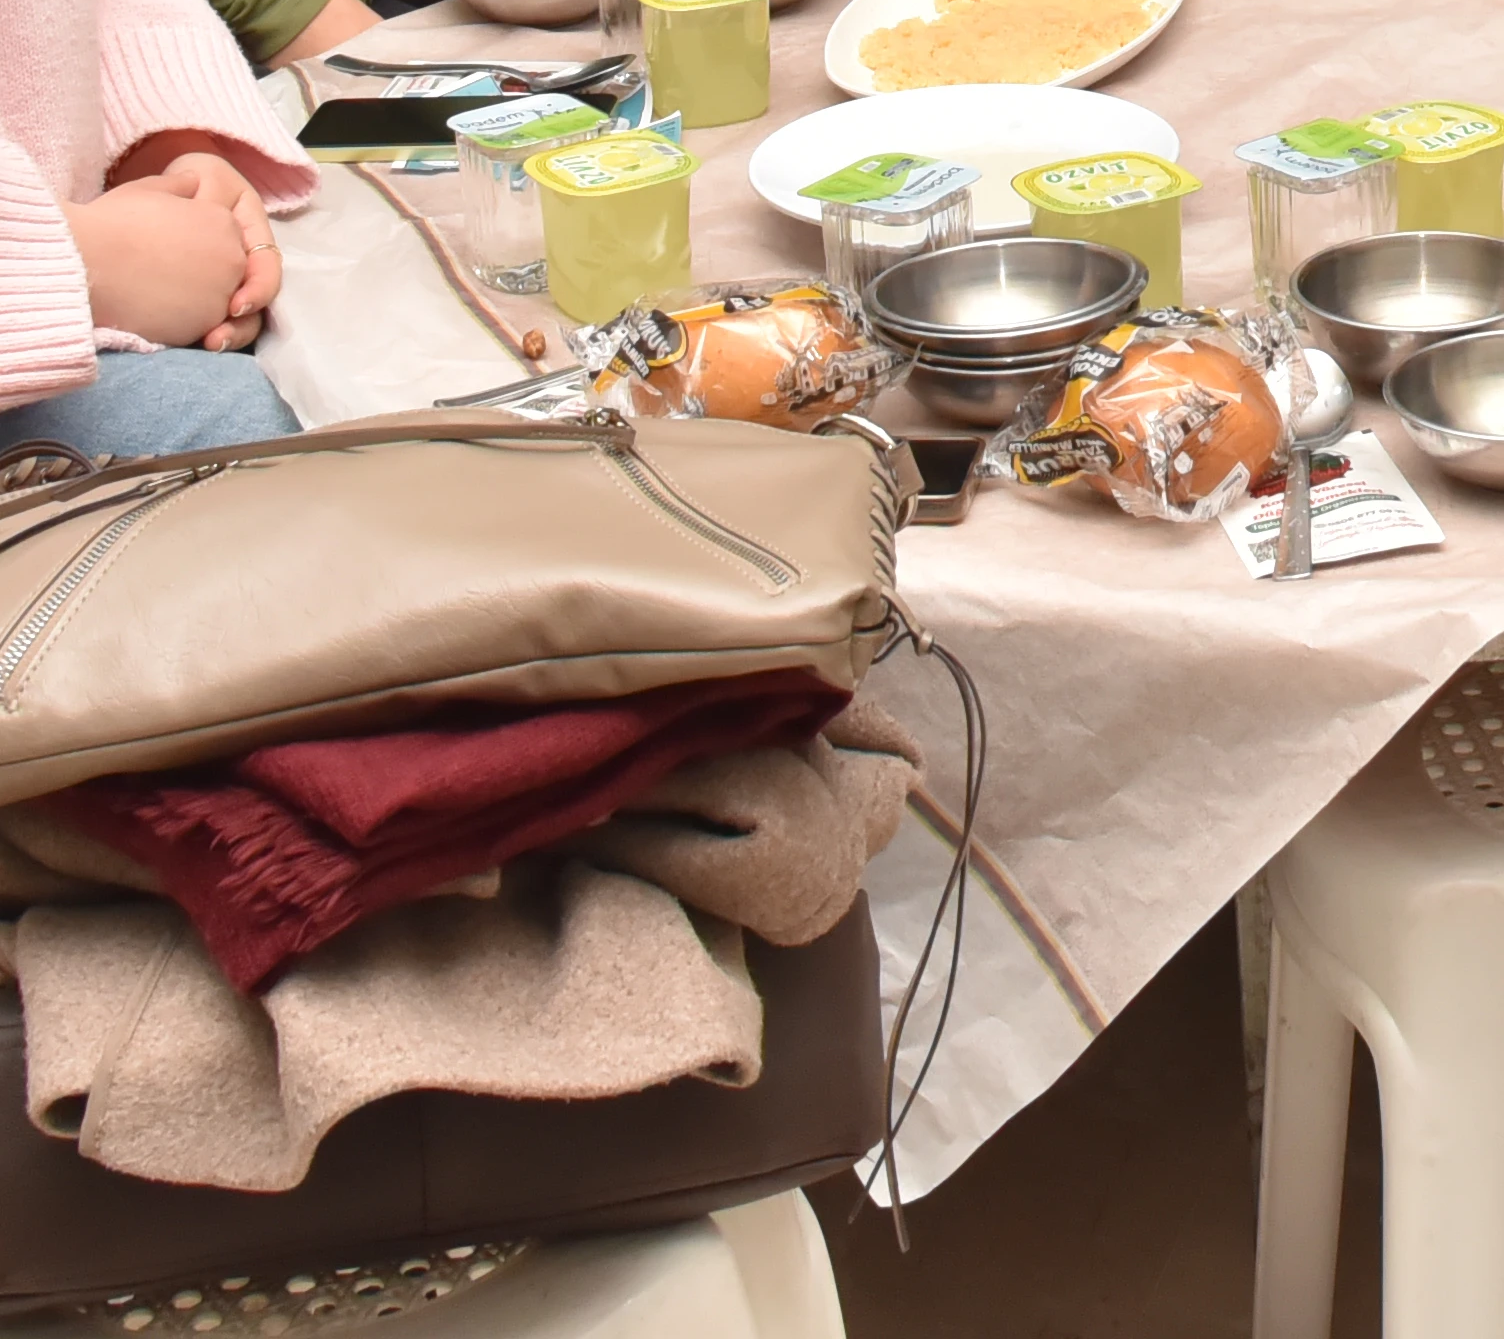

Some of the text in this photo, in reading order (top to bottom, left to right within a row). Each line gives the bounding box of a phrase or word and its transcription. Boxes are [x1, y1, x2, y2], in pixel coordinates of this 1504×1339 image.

[455, 111, 525, 129] badem
[1418, 120, 1492, 151] ÖZVİT
[554, 153, 615, 187] ÖZVİT
[1045, 160, 1129, 185] ÖZVİT
